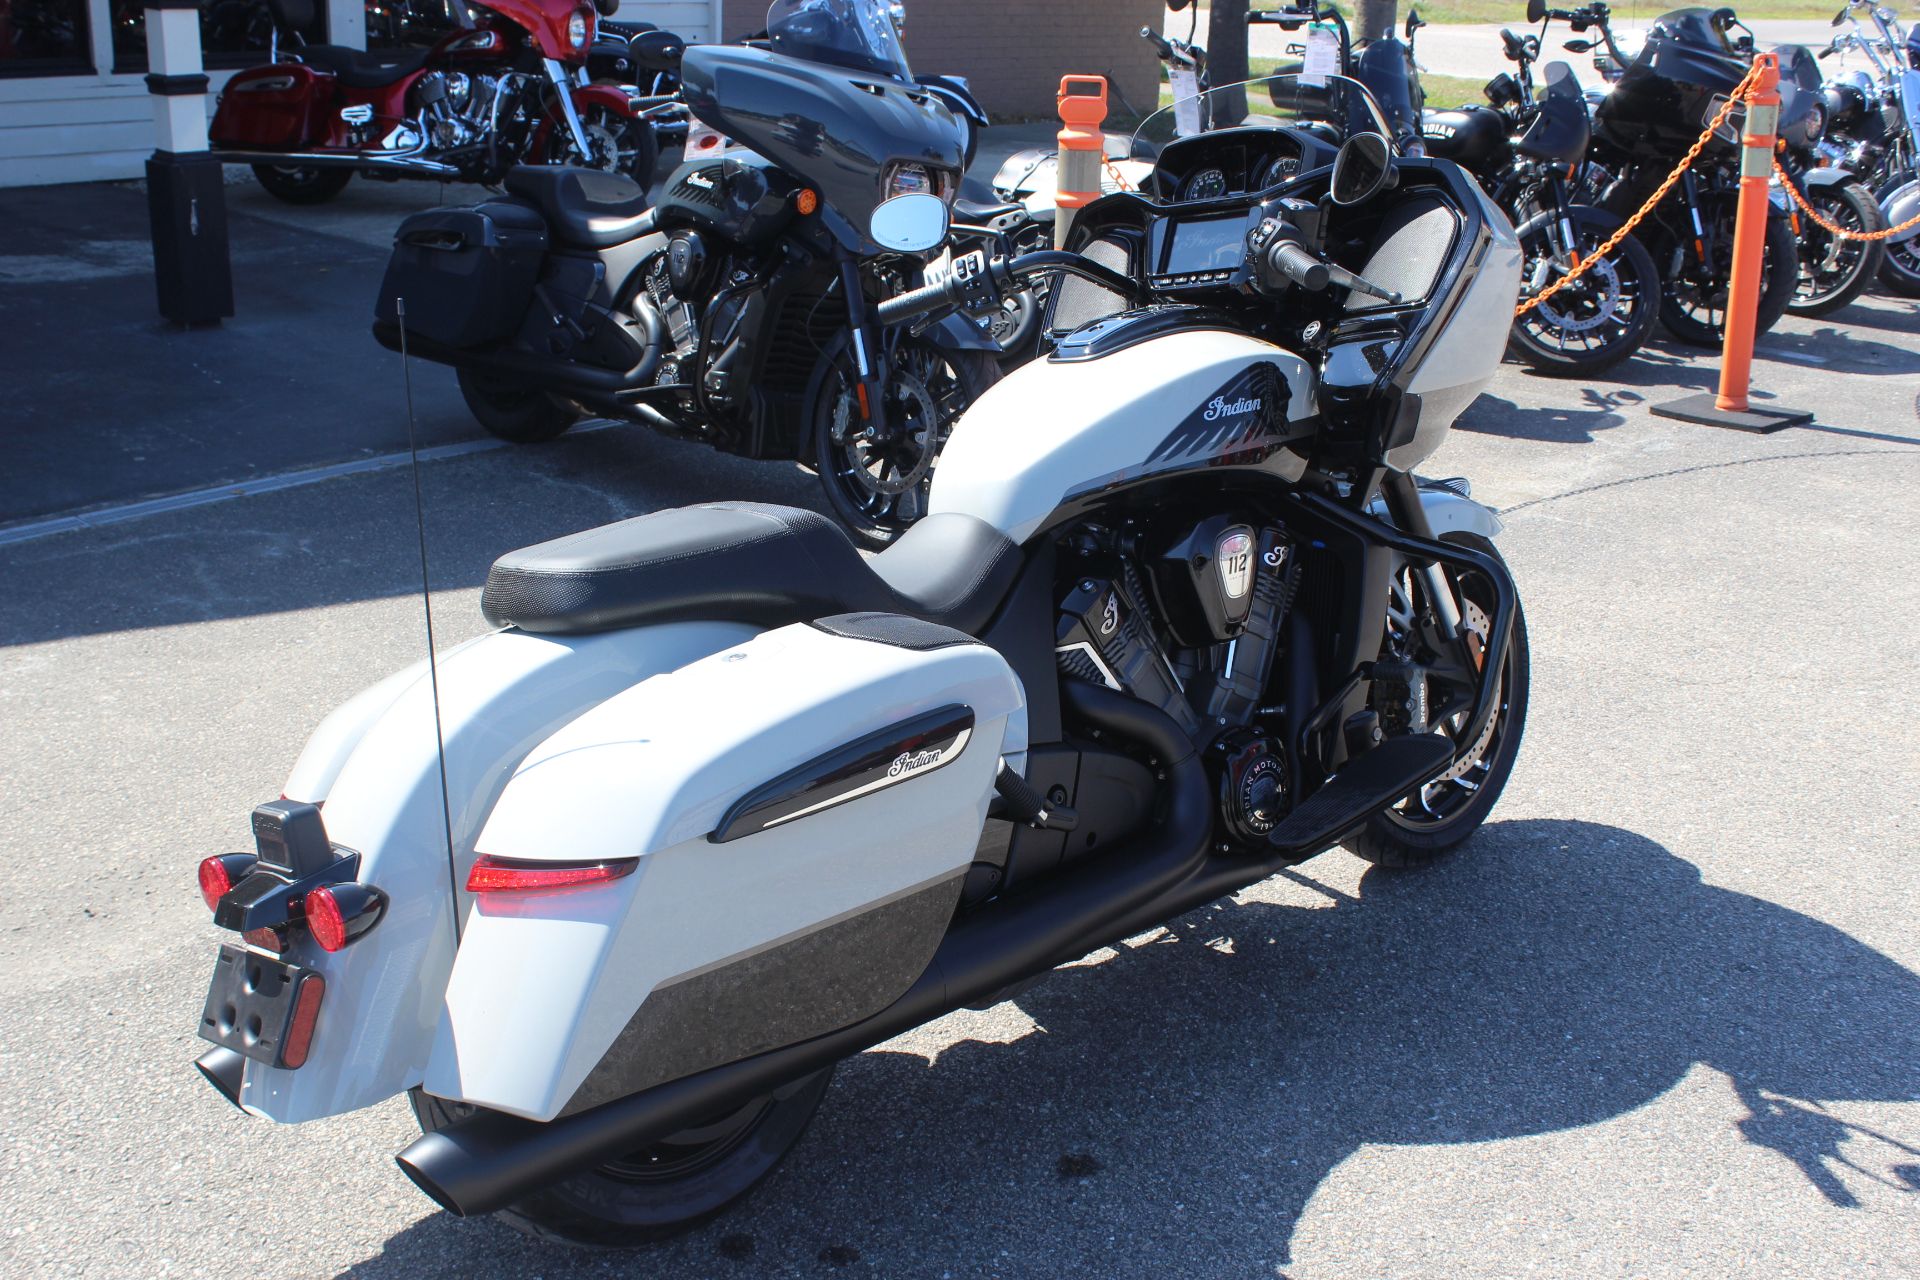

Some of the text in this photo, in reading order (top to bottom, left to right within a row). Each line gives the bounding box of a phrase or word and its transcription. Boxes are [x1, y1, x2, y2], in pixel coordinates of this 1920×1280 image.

[1422, 123, 1456, 138] NDIAN
[686, 171, 714, 189] Indian
[1203, 395, 1261, 421] Indian
[1228, 553, 1247, 575] 112
[888, 750, 942, 777] Indian
[1244, 776, 1255, 823] INDIAN
